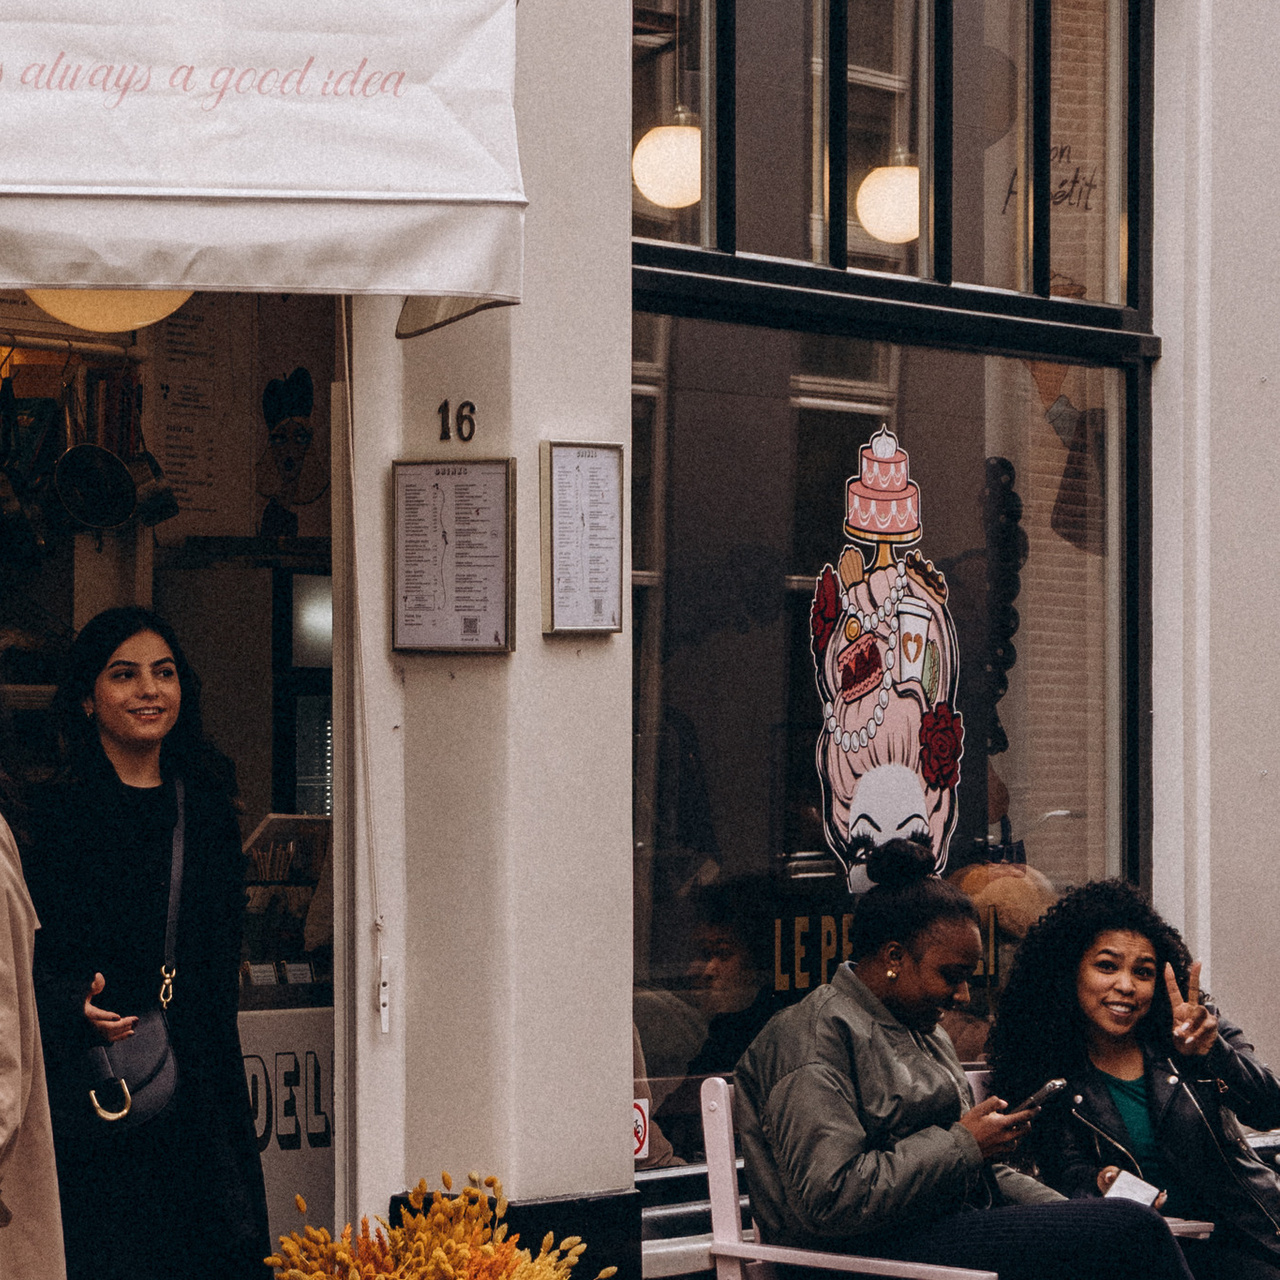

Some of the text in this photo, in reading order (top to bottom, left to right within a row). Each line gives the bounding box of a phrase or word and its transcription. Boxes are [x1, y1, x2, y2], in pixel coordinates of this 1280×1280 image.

[20, 50, 152, 110] always
[169, 64, 197, 92] a
[201, 55, 316, 112] good
[321, 57, 408, 98] idea
[1050, 144, 1071, 164] on
[1001, 166, 1098, 215] Aétit
[436, 398, 477, 442] 16
[774, 916, 810, 991] LE
[241, 1050, 335, 1154] DEL
